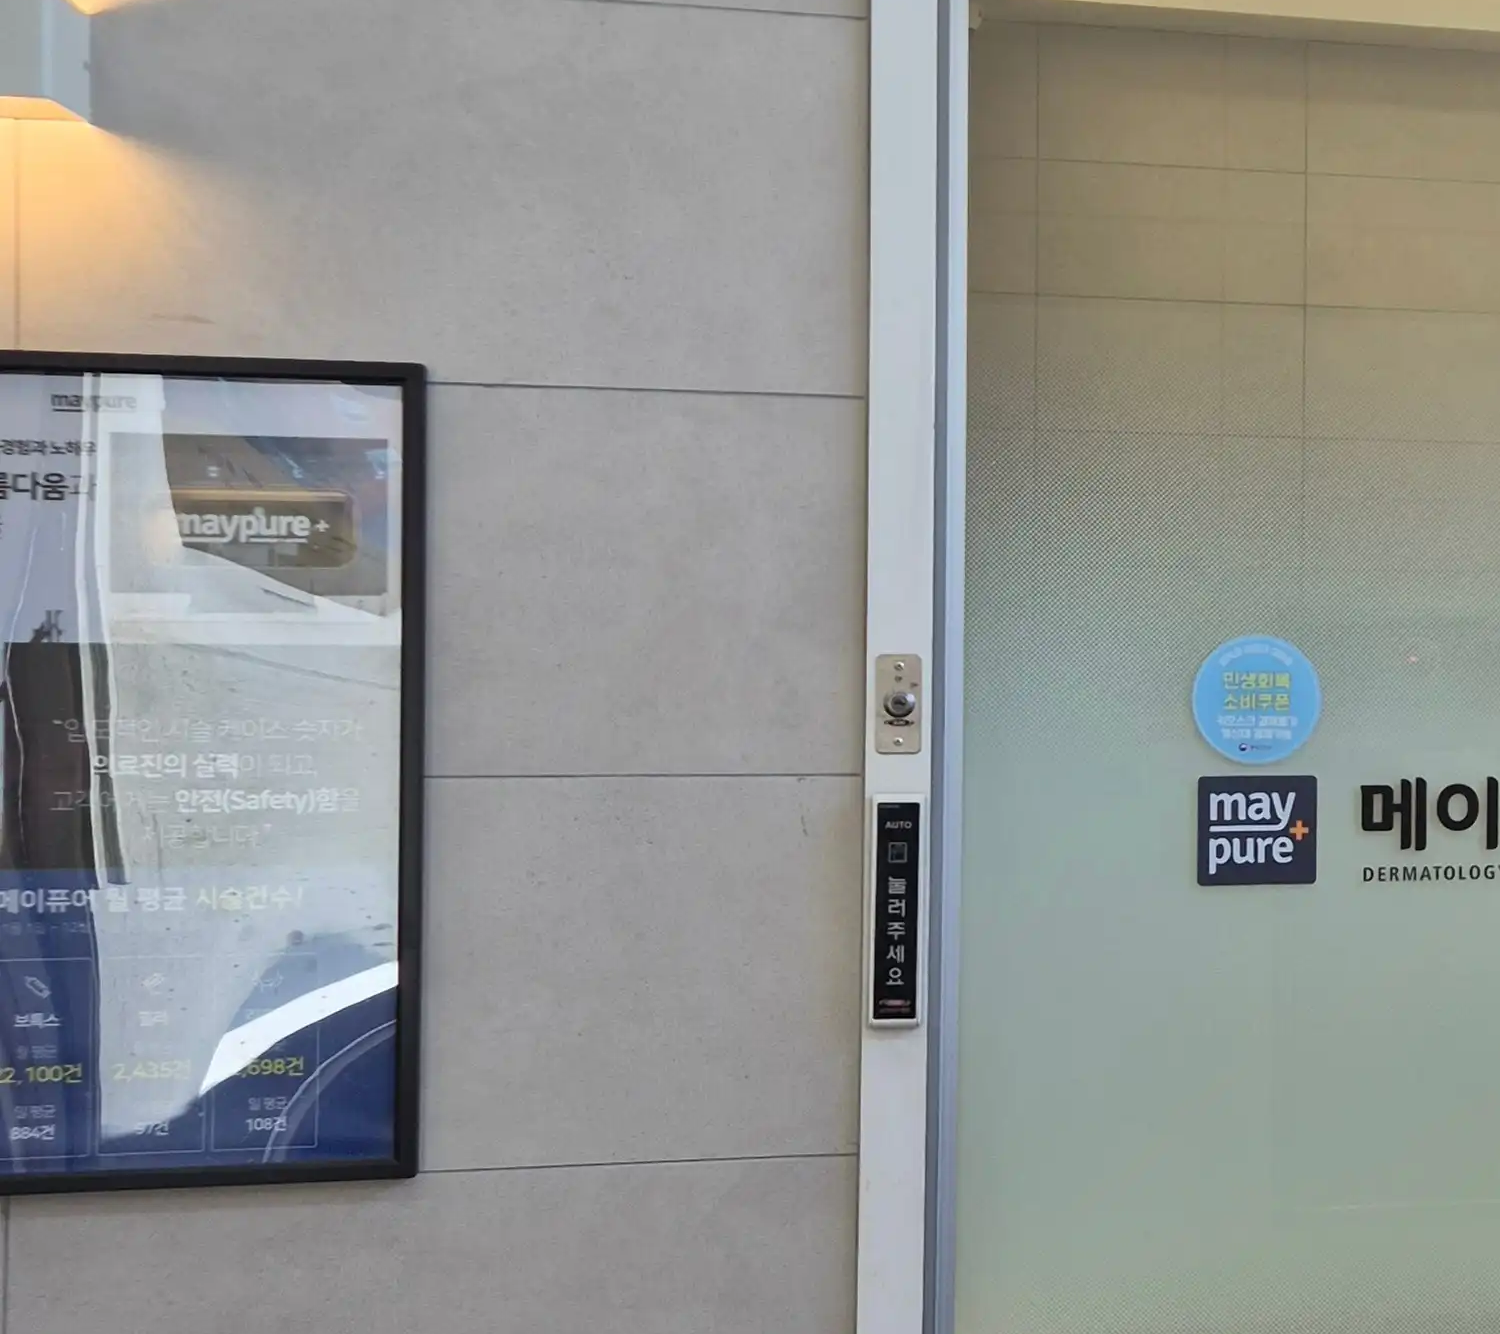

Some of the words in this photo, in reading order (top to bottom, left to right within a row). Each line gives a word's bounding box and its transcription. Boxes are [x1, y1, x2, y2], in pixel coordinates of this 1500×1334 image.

[1223, 693, 1290, 711] 소비쿠폰
[884, 819, 913, 831] AUTO
[1209, 790, 1297, 834] may
[1208, 834, 1295, 875] pure
[885, 875, 908, 987] 눌러주세요
